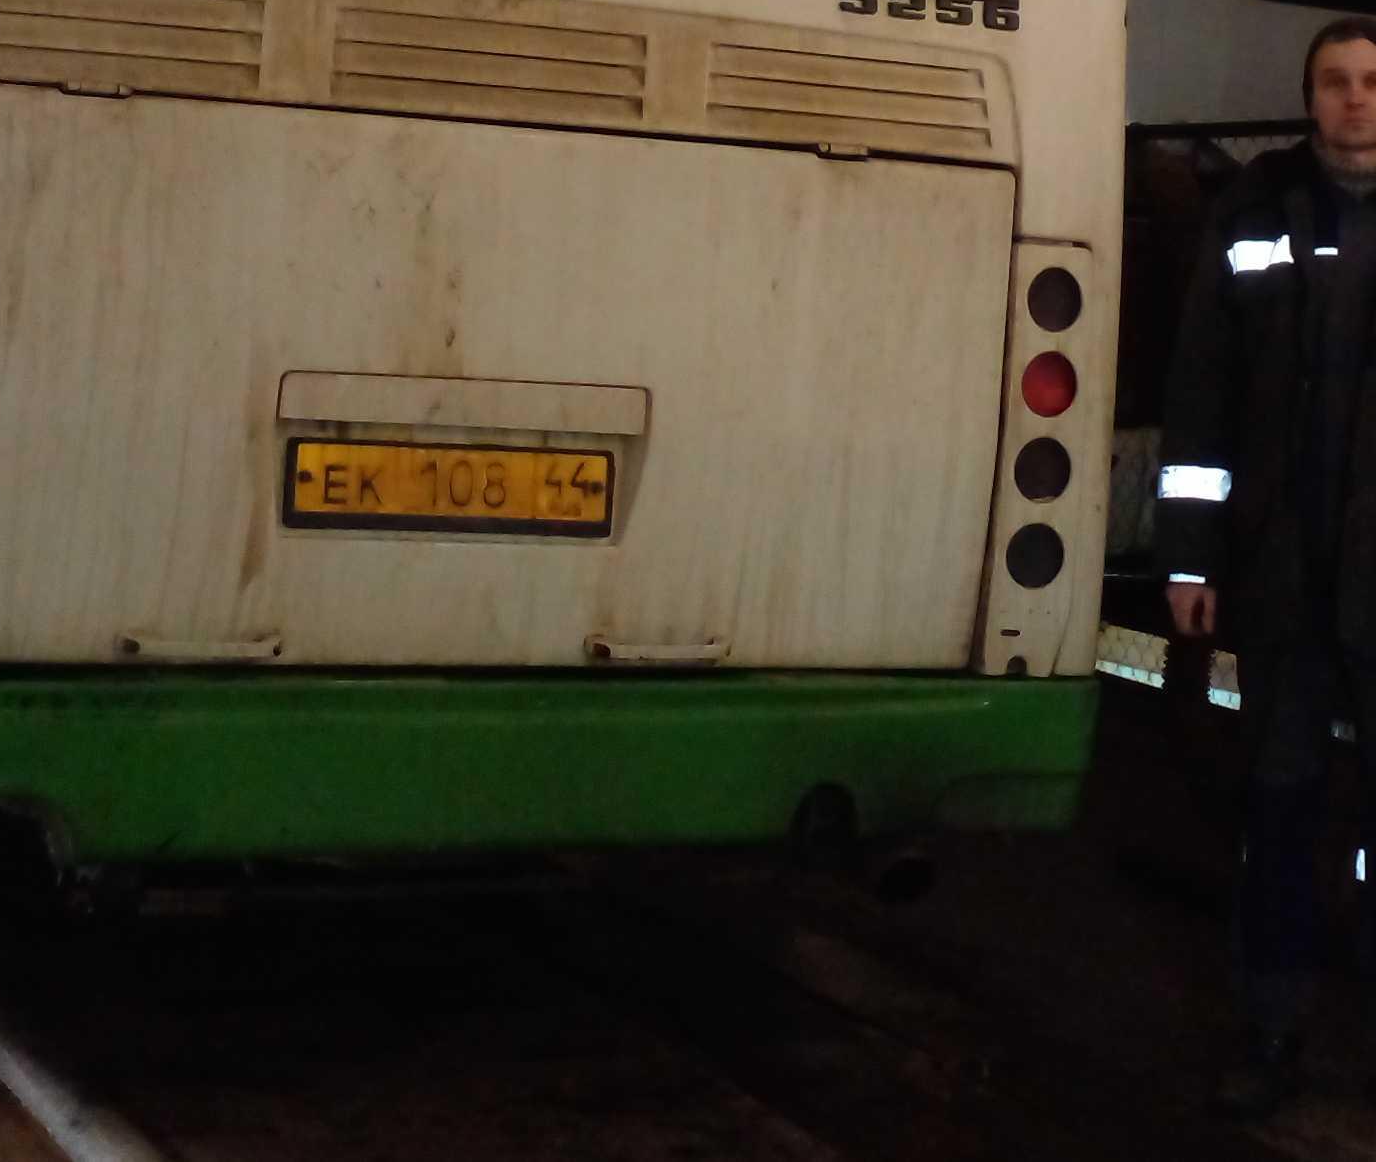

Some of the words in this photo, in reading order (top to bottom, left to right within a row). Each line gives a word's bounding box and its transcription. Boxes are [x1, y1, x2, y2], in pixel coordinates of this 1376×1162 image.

[322, 463, 384, 506] ЕК
[419, 458, 508, 510] 108
[544, 460, 590, 499] 44
